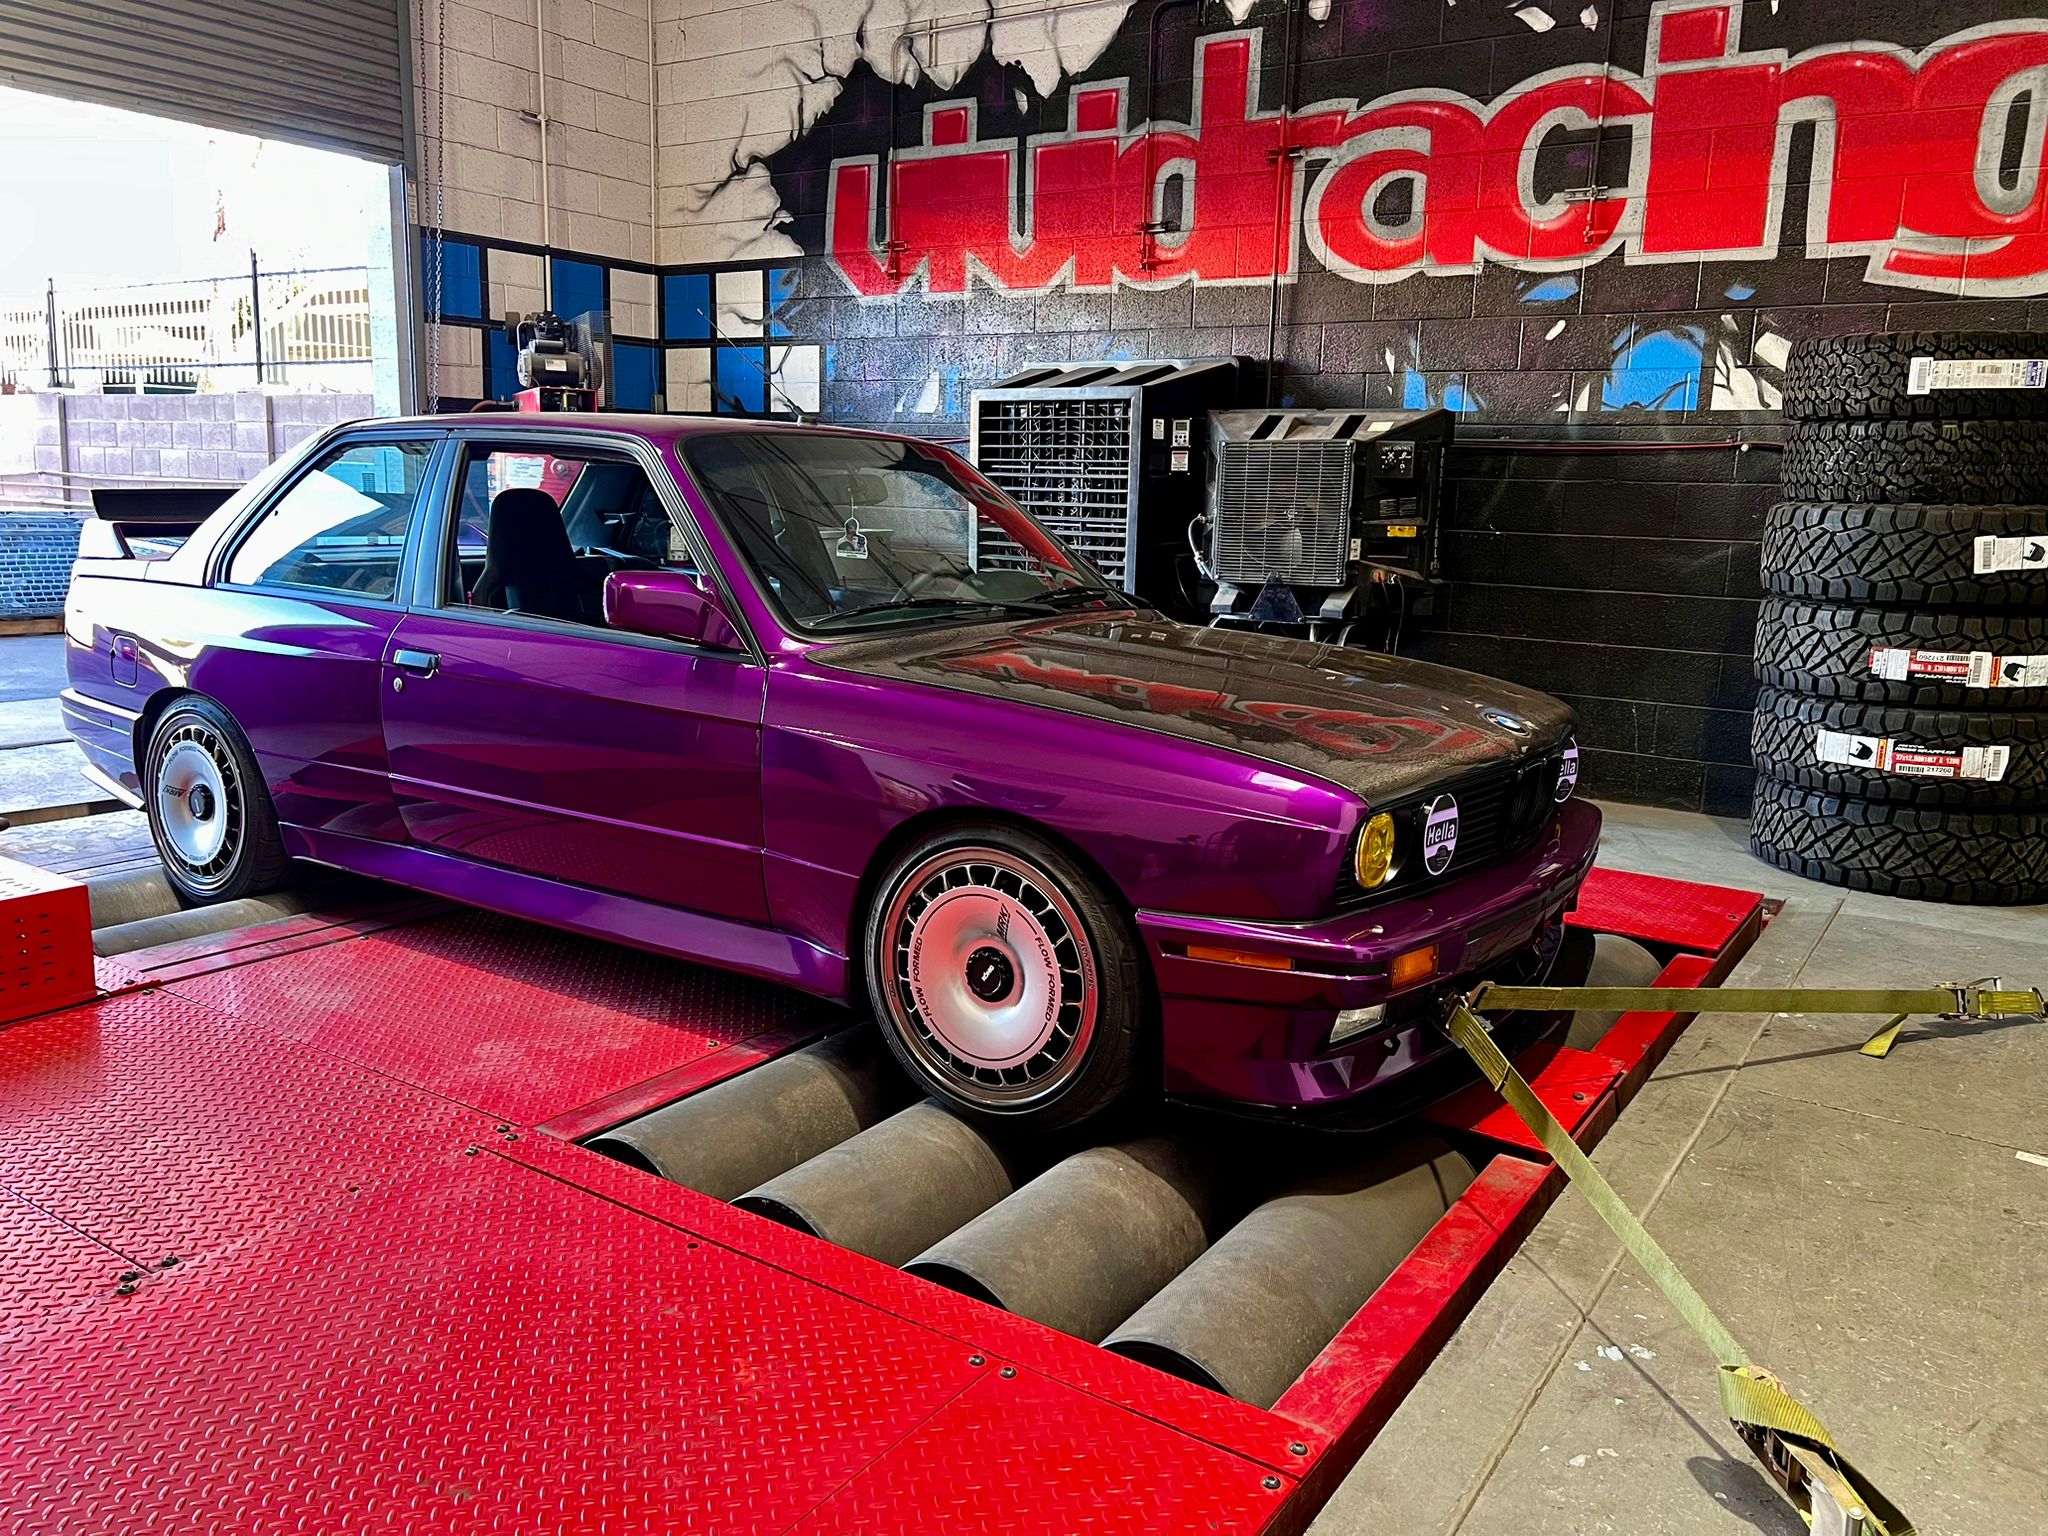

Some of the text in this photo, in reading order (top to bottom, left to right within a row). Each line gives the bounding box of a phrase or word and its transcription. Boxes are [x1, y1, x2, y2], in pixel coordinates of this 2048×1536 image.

[1560, 760, 1576, 775] ella
[1926, 766, 1952, 774] 217260
[1427, 821, 1455, 846] Hella
[912, 938, 932, 1017] FLOW FORMED
[1035, 937, 1056, 1022] FLOW FORMED
